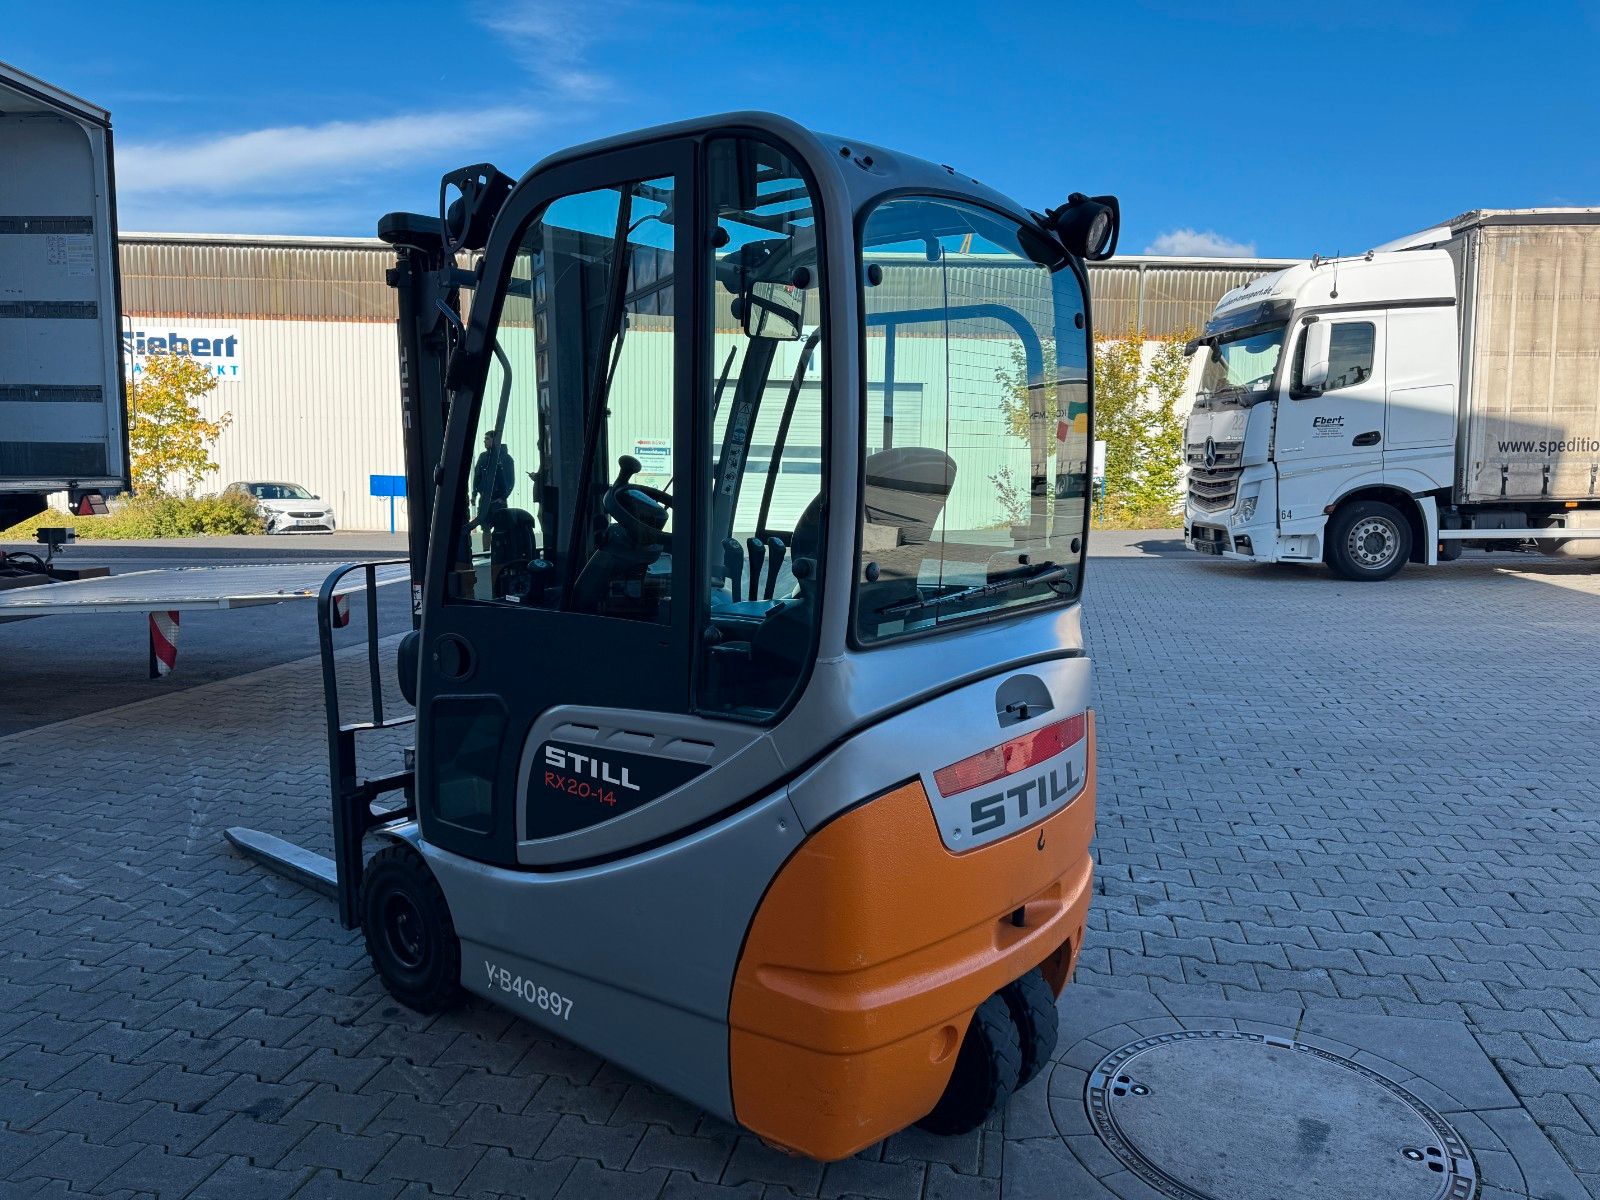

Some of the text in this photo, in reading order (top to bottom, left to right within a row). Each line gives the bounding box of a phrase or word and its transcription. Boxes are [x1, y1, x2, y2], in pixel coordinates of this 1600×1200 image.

[1312, 416, 1344, 427] Ebert
[1497, 437, 1600, 456] www.speditio
[1281, 510, 1292, 520] 64
[545, 745, 640, 791] STILL
[971, 761, 1080, 836] STILL
